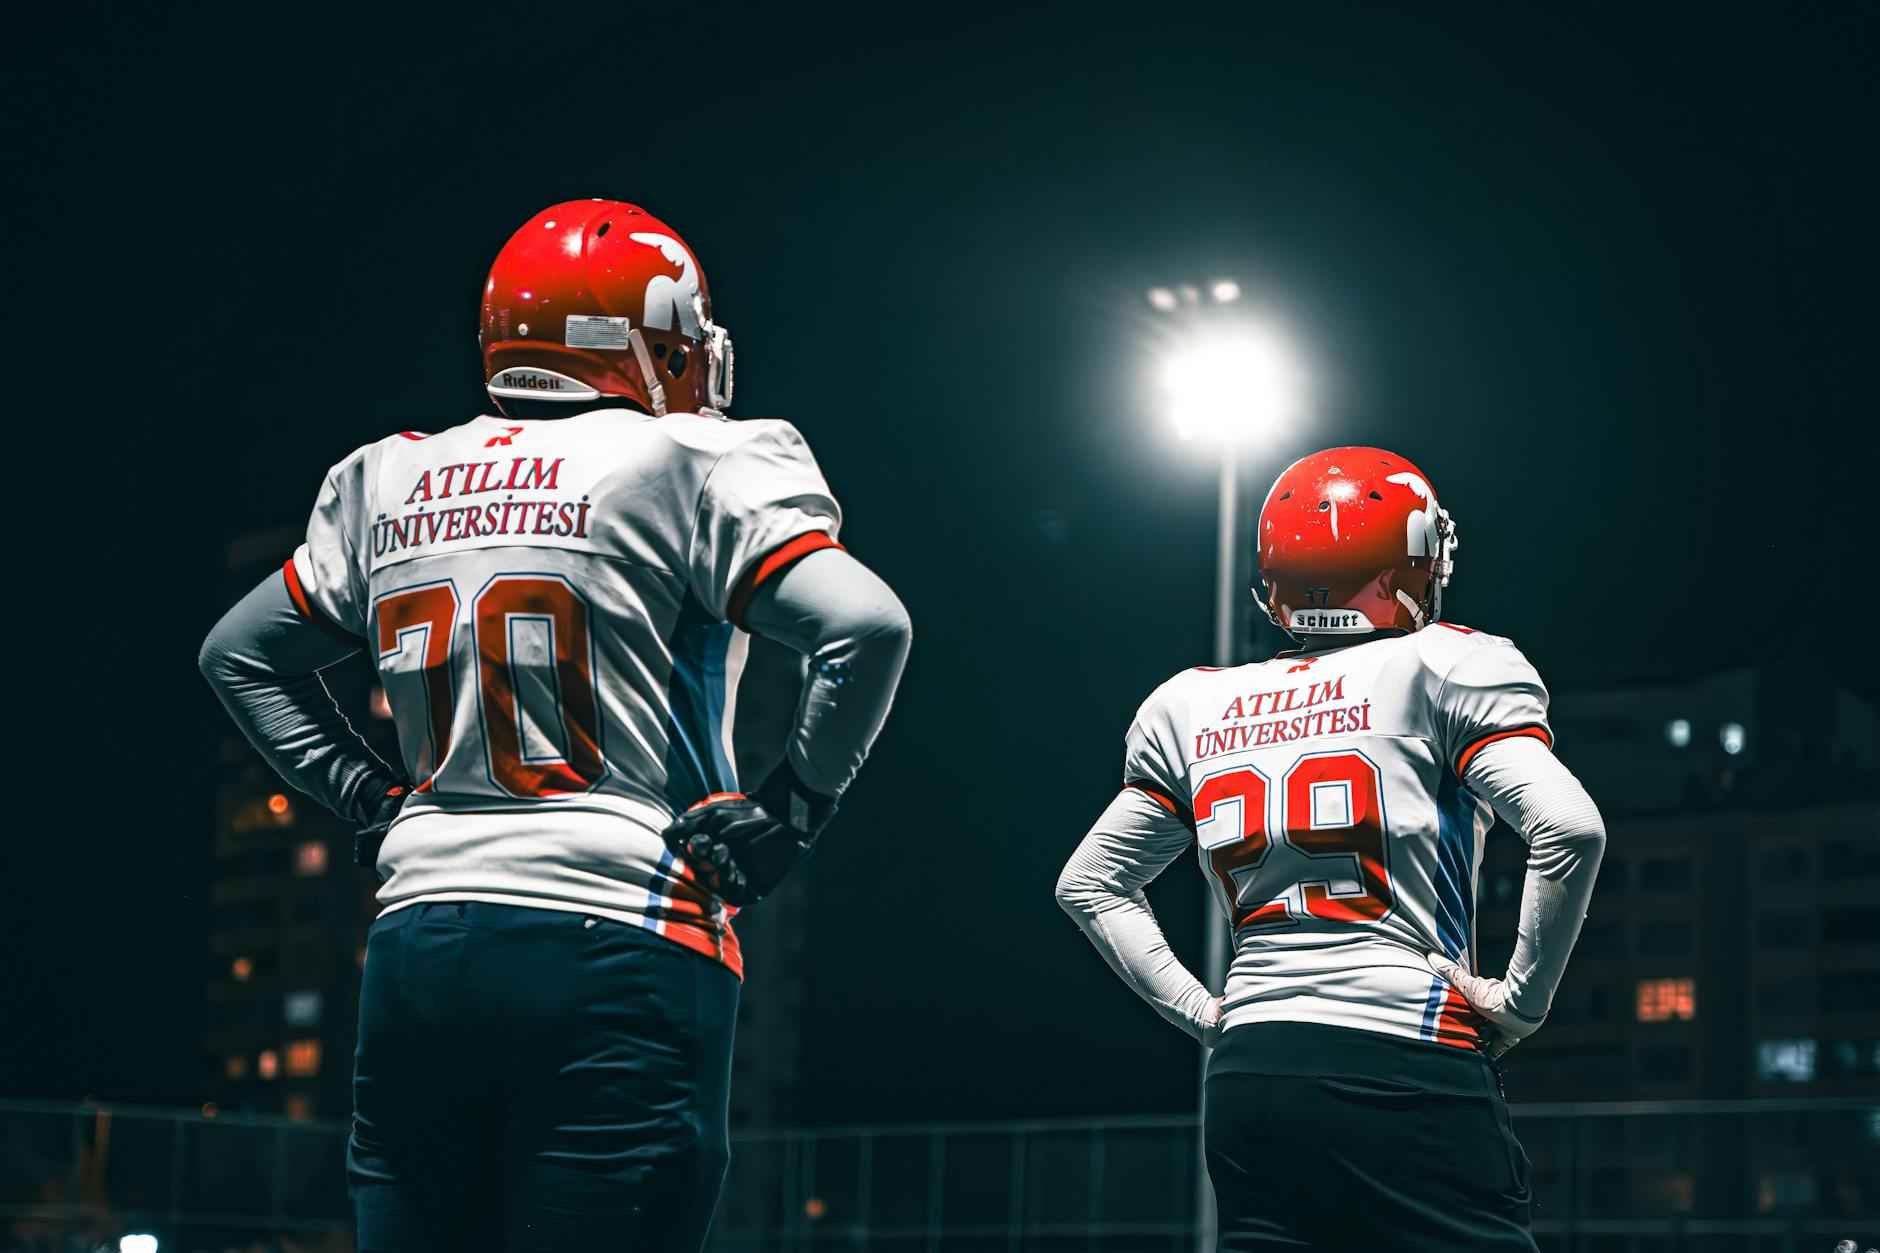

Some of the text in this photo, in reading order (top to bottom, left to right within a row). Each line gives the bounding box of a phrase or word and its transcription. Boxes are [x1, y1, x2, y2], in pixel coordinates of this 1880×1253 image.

[502, 373, 560, 390] Riddell
[404, 457, 565, 505] ATILIM
[372, 494, 591, 558] ÜNİVERSİTESİ
[373, 572, 612, 799] 70
[1222, 674, 1346, 720] ATILIM
[1195, 698, 1371, 759] ÜNİVERSİTESİ
[1192, 749, 1397, 930] 29
